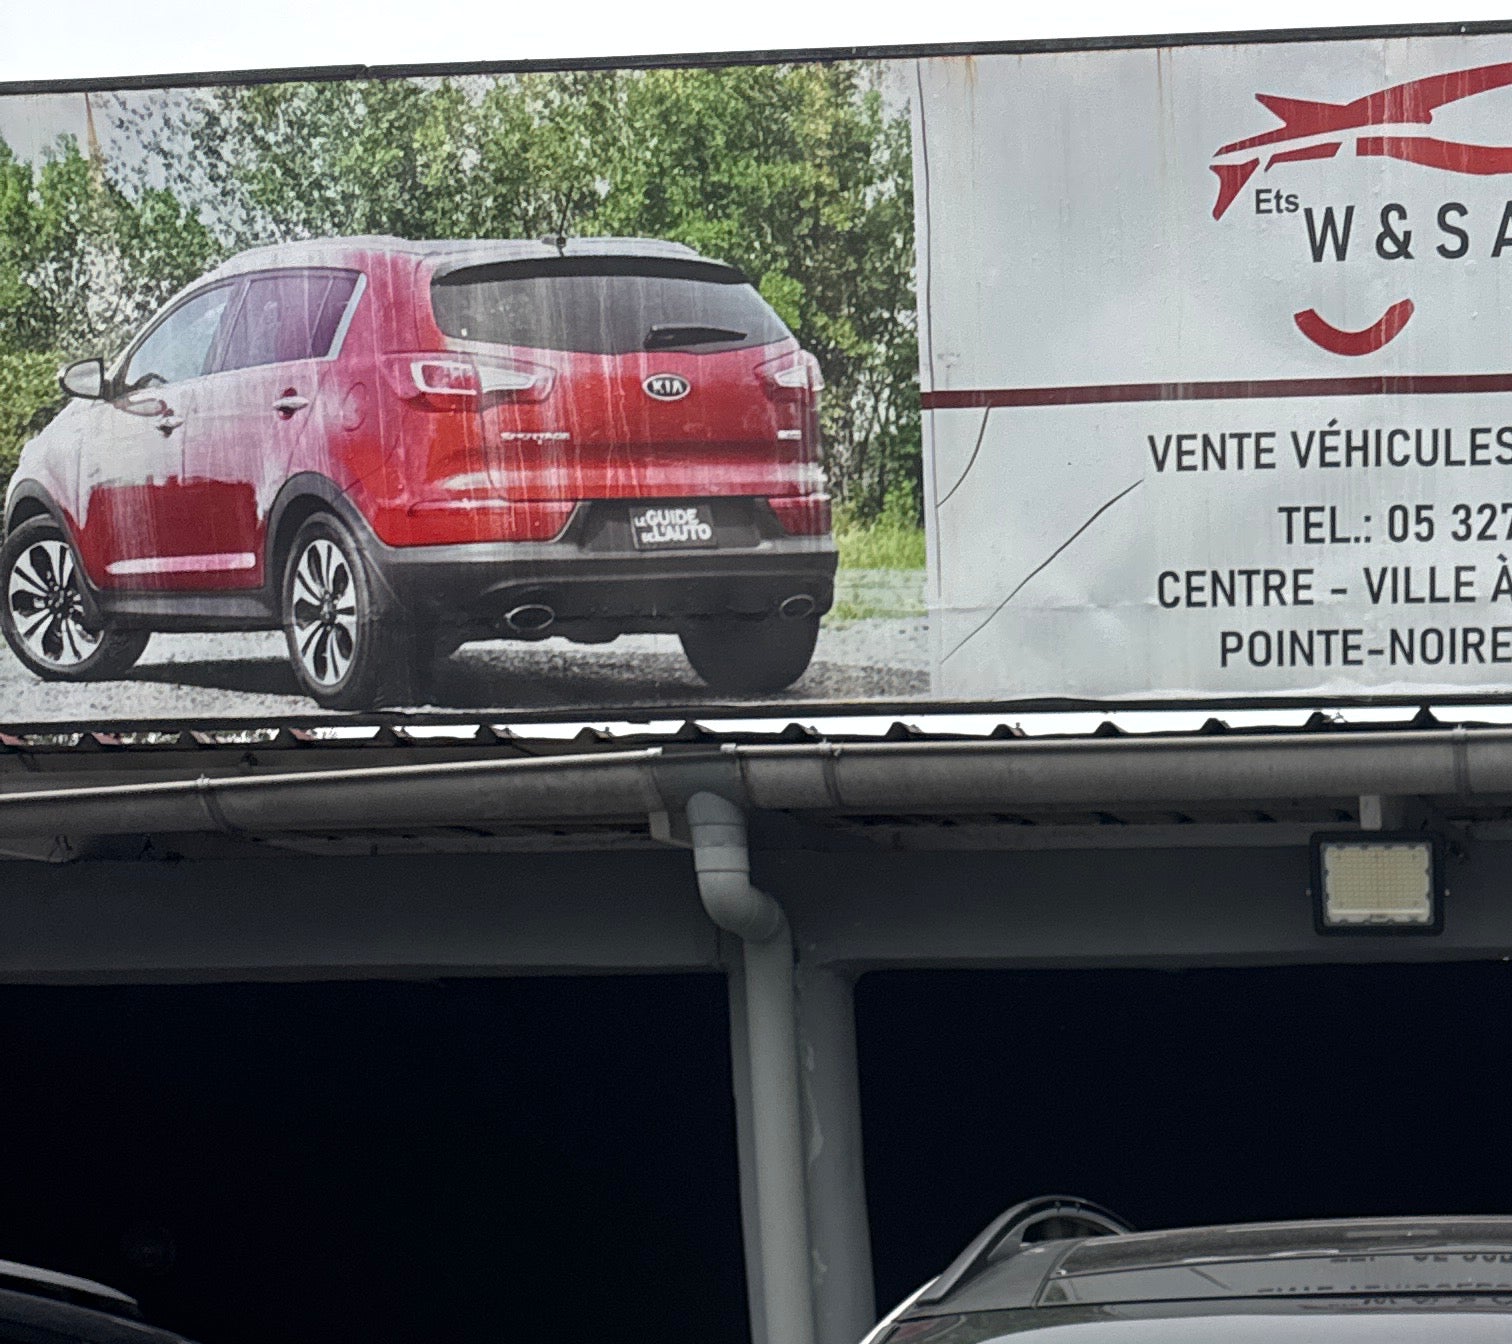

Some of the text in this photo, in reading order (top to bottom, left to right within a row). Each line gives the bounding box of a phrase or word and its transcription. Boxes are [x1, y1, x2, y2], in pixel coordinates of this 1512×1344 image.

[1256, 189, 1299, 214] Ets
[1304, 206, 1355, 262] W
[1376, 203, 1414, 260] &
[1436, 202, 1469, 259] S
[651, 379, 684, 394] KIA
[1148, 432, 1276, 472] VENTE
[645, 508, 700, 526] GUIDE
[1277, 506, 1371, 544] TEL.:
[1389, 504, 1434, 542] 05
[1158, 569, 1314, 608] CENTRE
[1363, 566, 1476, 604] VILLE
